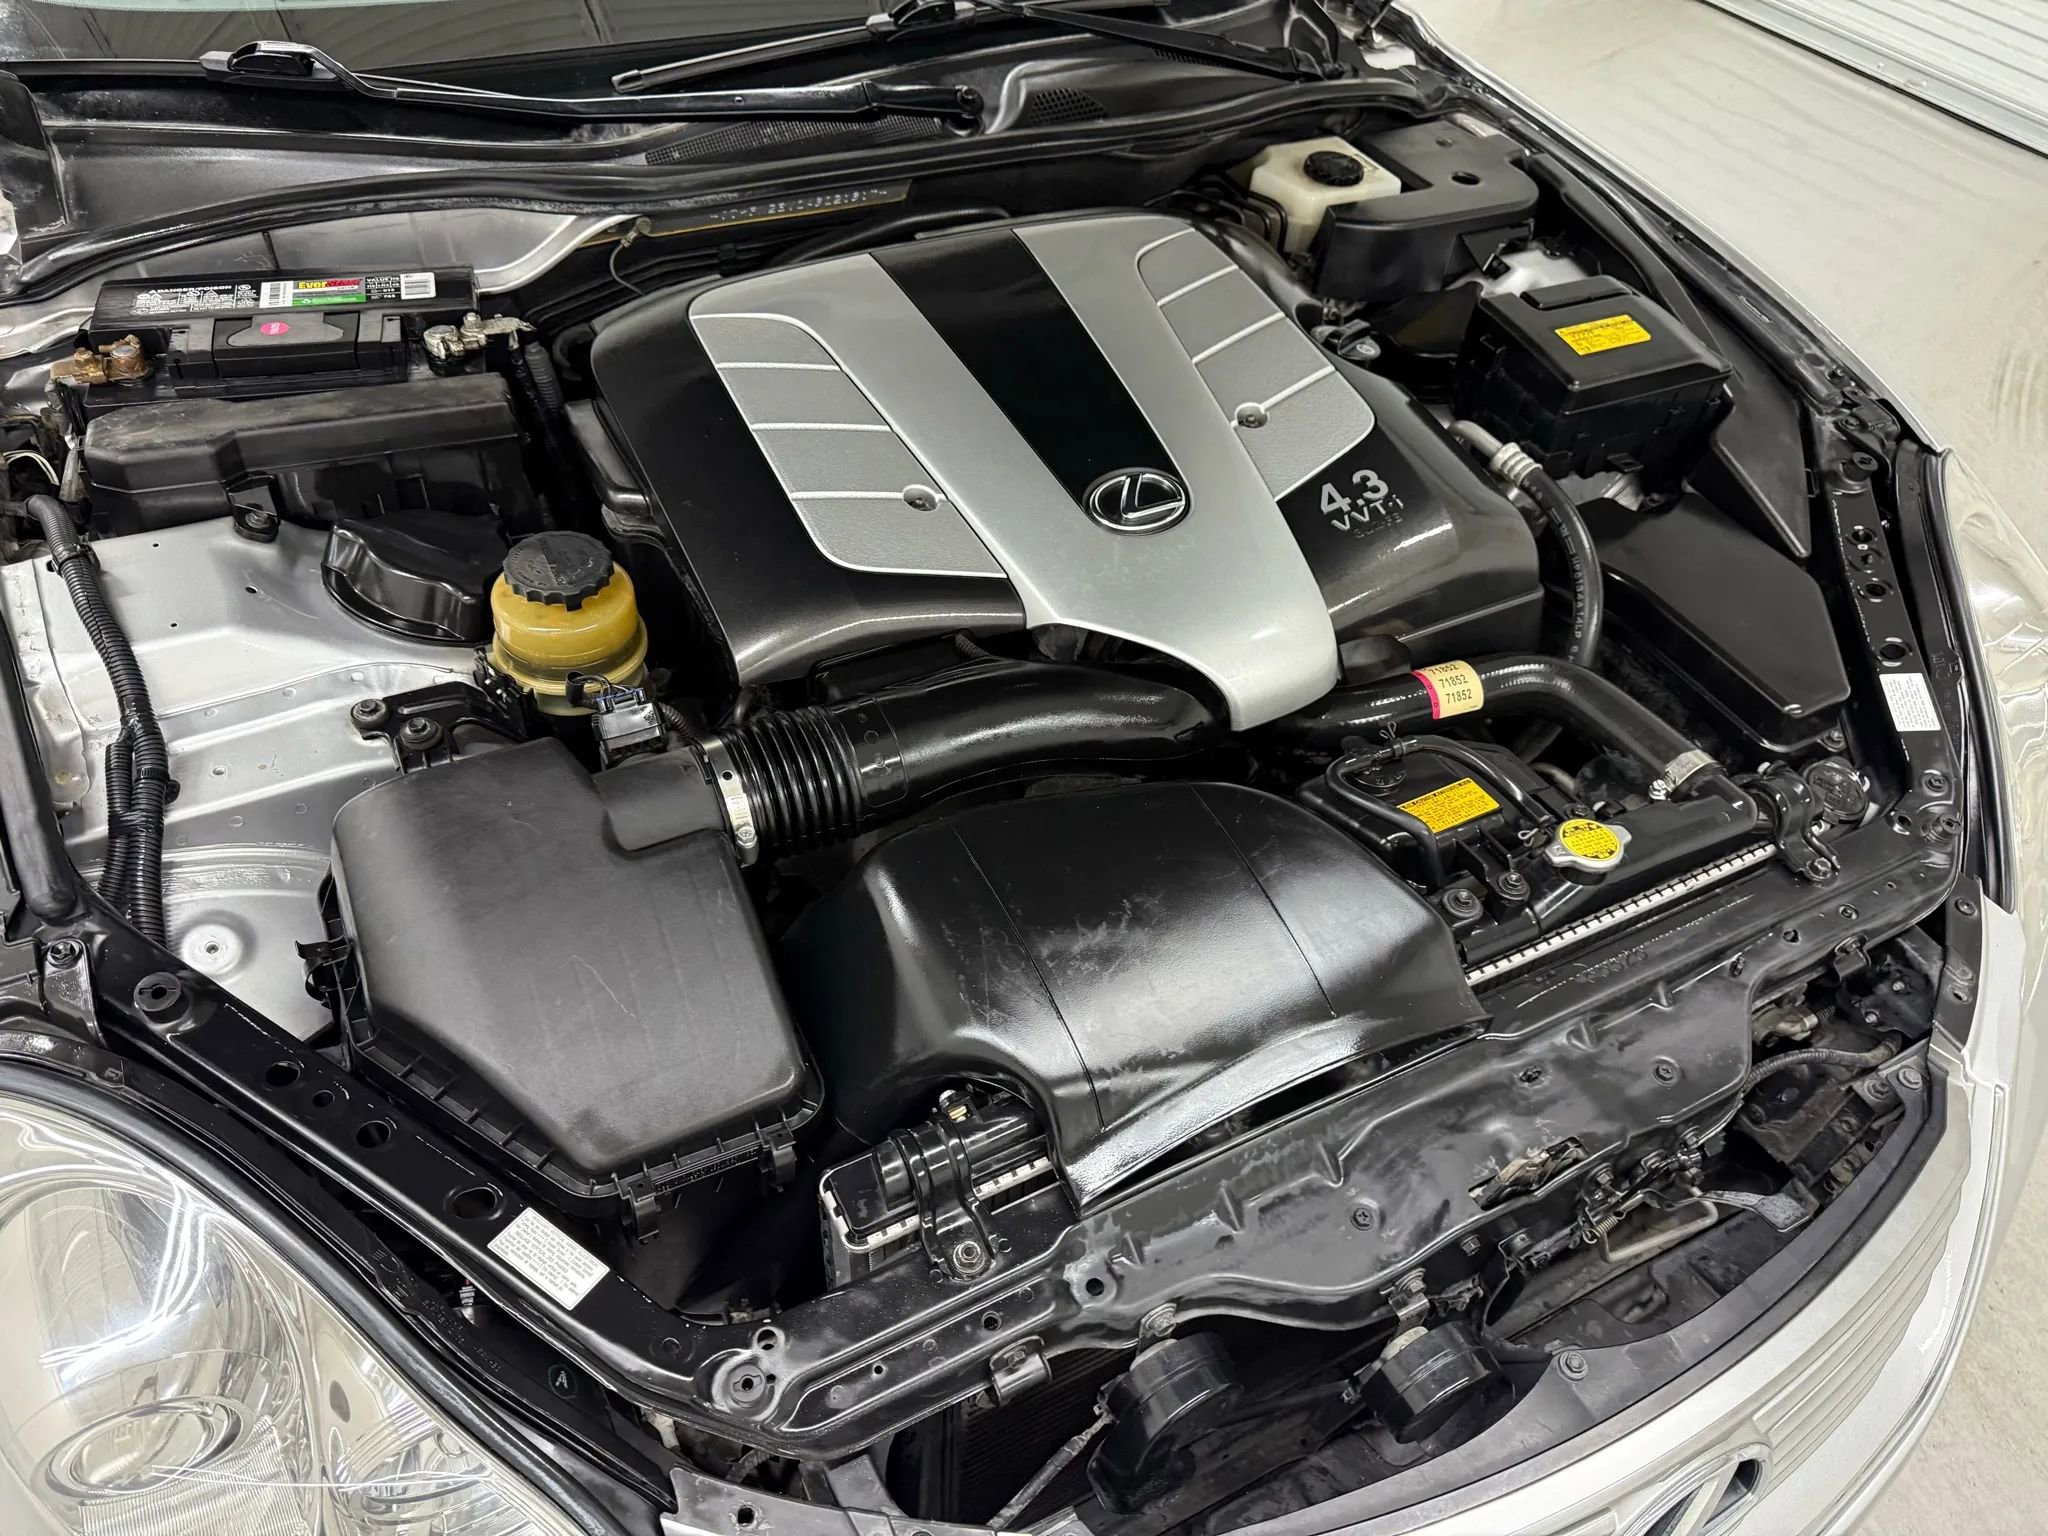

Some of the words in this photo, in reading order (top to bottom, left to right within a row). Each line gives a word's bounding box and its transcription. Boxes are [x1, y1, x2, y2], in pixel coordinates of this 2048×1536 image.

[1320, 469, 1389, 515] 4.3
[1428, 664, 1460, 676] 71852
[1438, 674, 1469, 689] 71852
[1445, 688, 1473, 704] 71852
